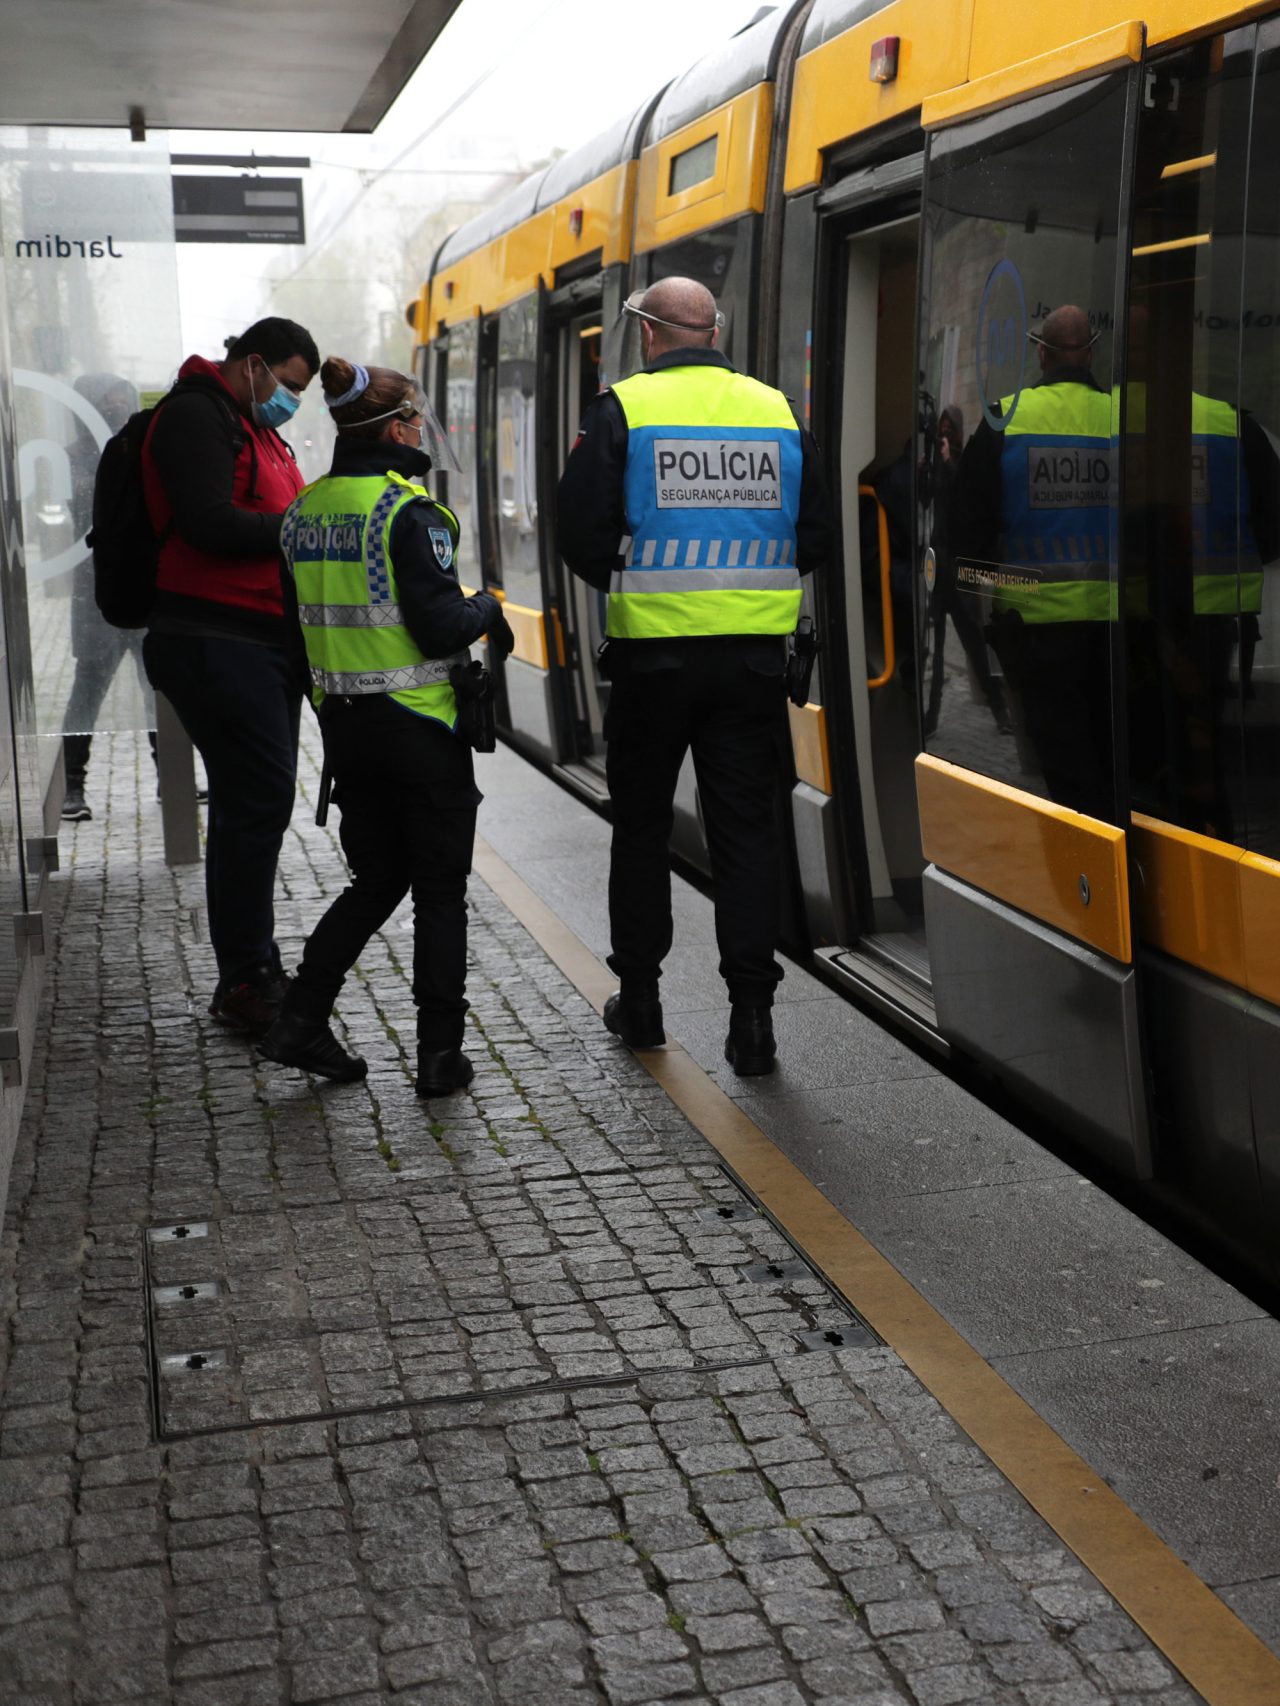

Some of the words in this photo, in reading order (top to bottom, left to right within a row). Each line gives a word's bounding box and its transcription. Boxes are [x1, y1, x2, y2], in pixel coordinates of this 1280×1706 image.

[658, 444, 777, 481] POLÍCIA
[661, 489, 731, 503] SEGURANÇA
[733, 487, 778, 501] PÚBLICA
